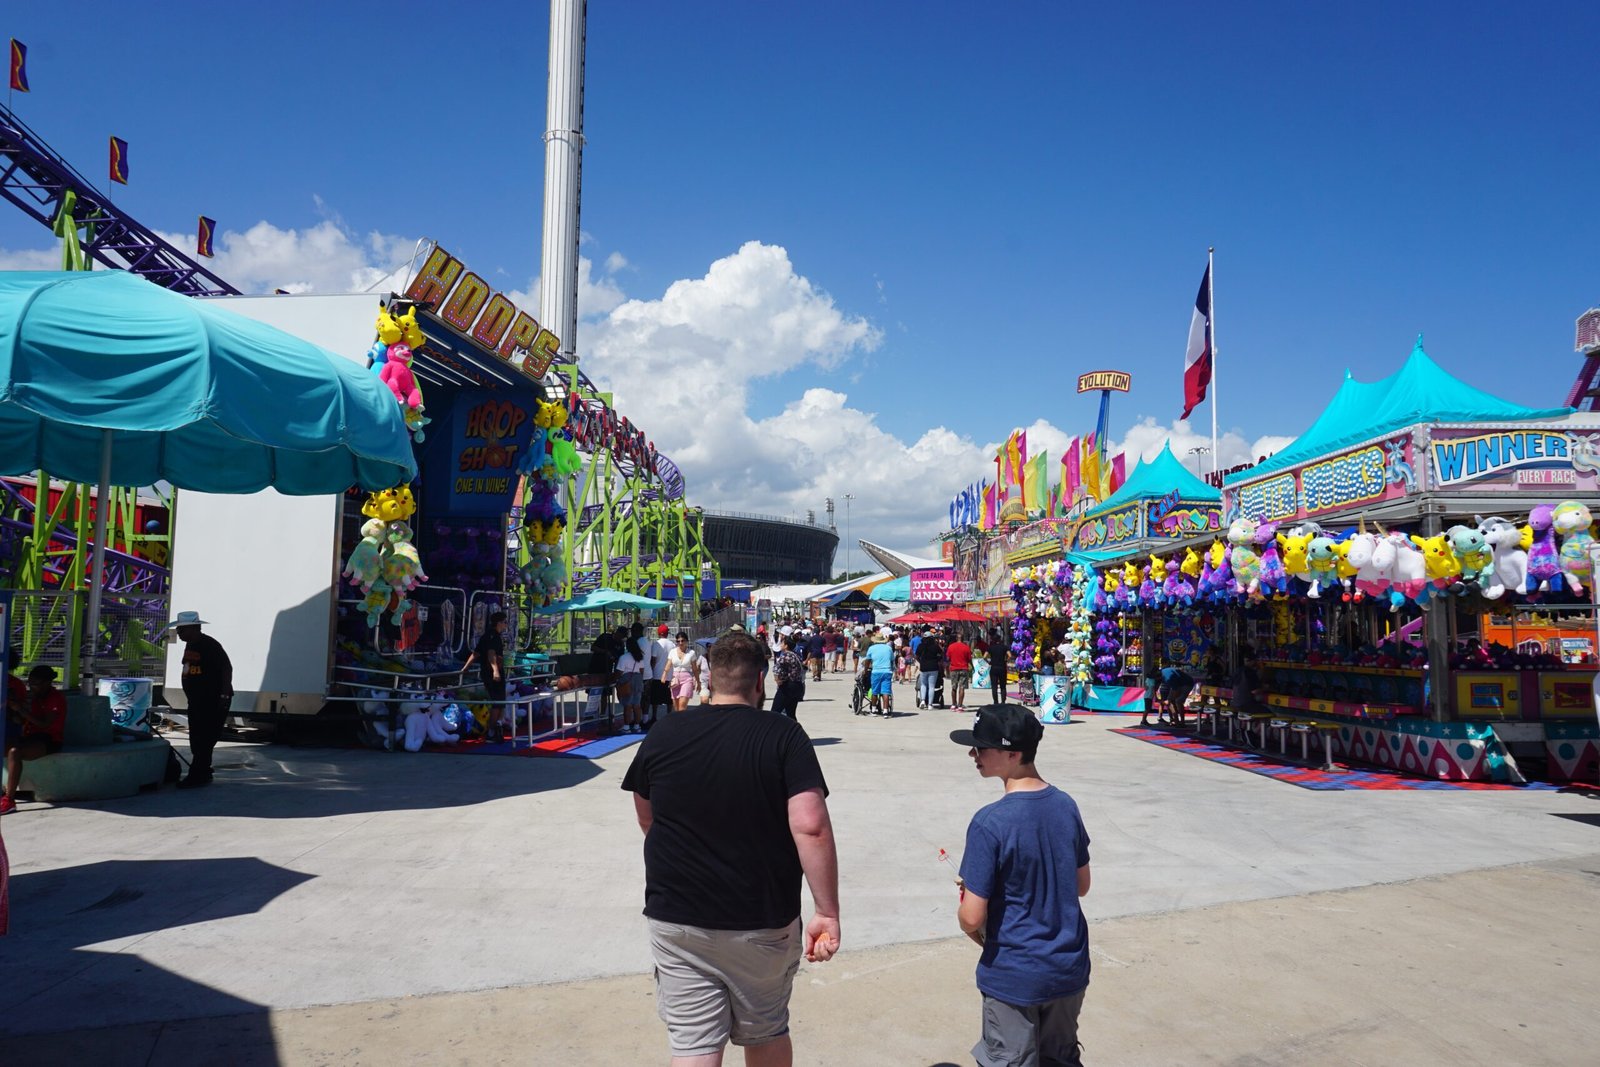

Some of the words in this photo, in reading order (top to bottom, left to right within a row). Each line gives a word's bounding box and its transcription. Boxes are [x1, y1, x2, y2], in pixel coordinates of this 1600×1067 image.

[404, 246, 560, 379] HOOPS
[1079, 374, 1128, 390] EVOLUTION
[465, 400, 525, 438] HOOP
[1435, 433, 1567, 481] WINNER
[456, 478, 473, 493] ONE
[475, 479, 484, 493] IN
[485, 478, 510, 493] WINS!
[1241, 477, 1295, 523] WATER
[1302, 448, 1384, 511] WORKS
[1519, 470, 1546, 483] EVERY
[1551, 470, 1577, 483] RACE
[1150, 488, 1180, 523] CALI
[1163, 510, 1207, 536] TOY
[1080, 519, 1106, 546] TOY
[1107, 510, 1138, 540] BOX
